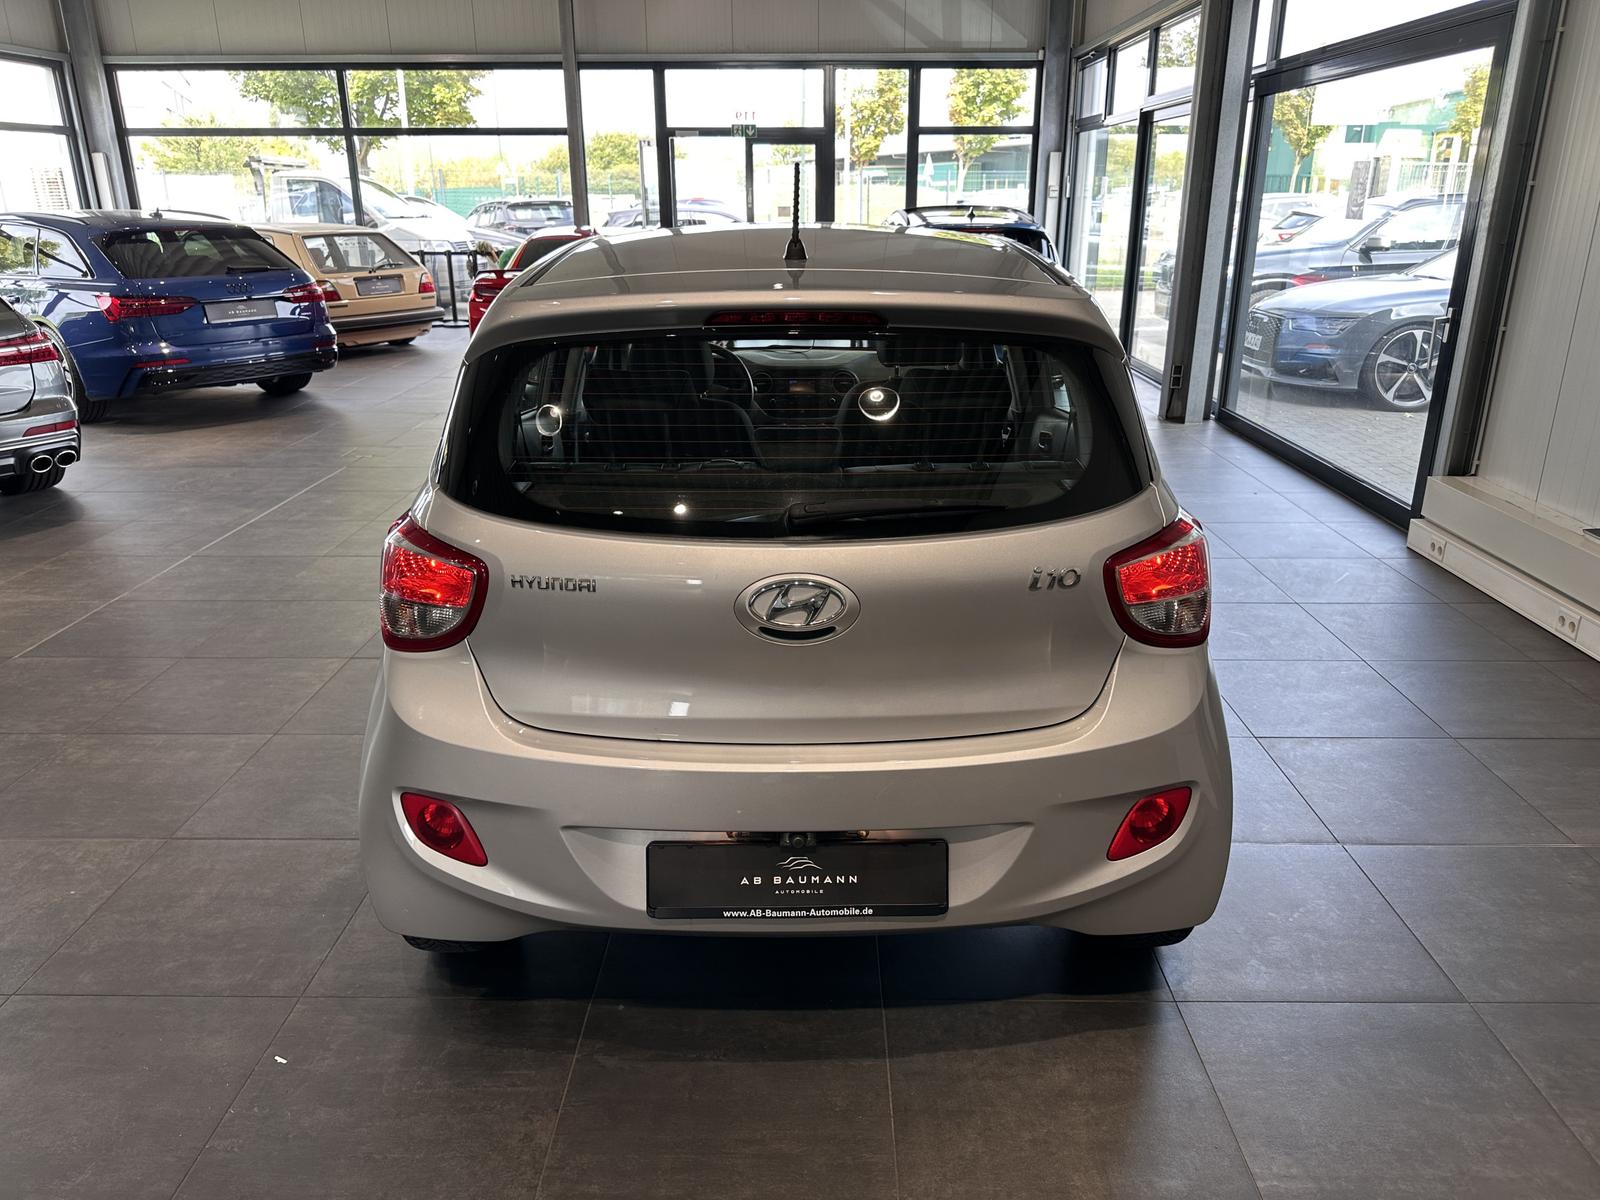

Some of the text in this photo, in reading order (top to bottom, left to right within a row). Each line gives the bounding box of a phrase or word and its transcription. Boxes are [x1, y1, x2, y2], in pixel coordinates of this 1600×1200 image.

[510, 574, 597, 593] HYUNDAI
[1028, 566, 1081, 592] i10
[740, 875, 858, 885] AB BAUMANN
[723, 907, 873, 917] www.AB-Baumann-Automobile.de
